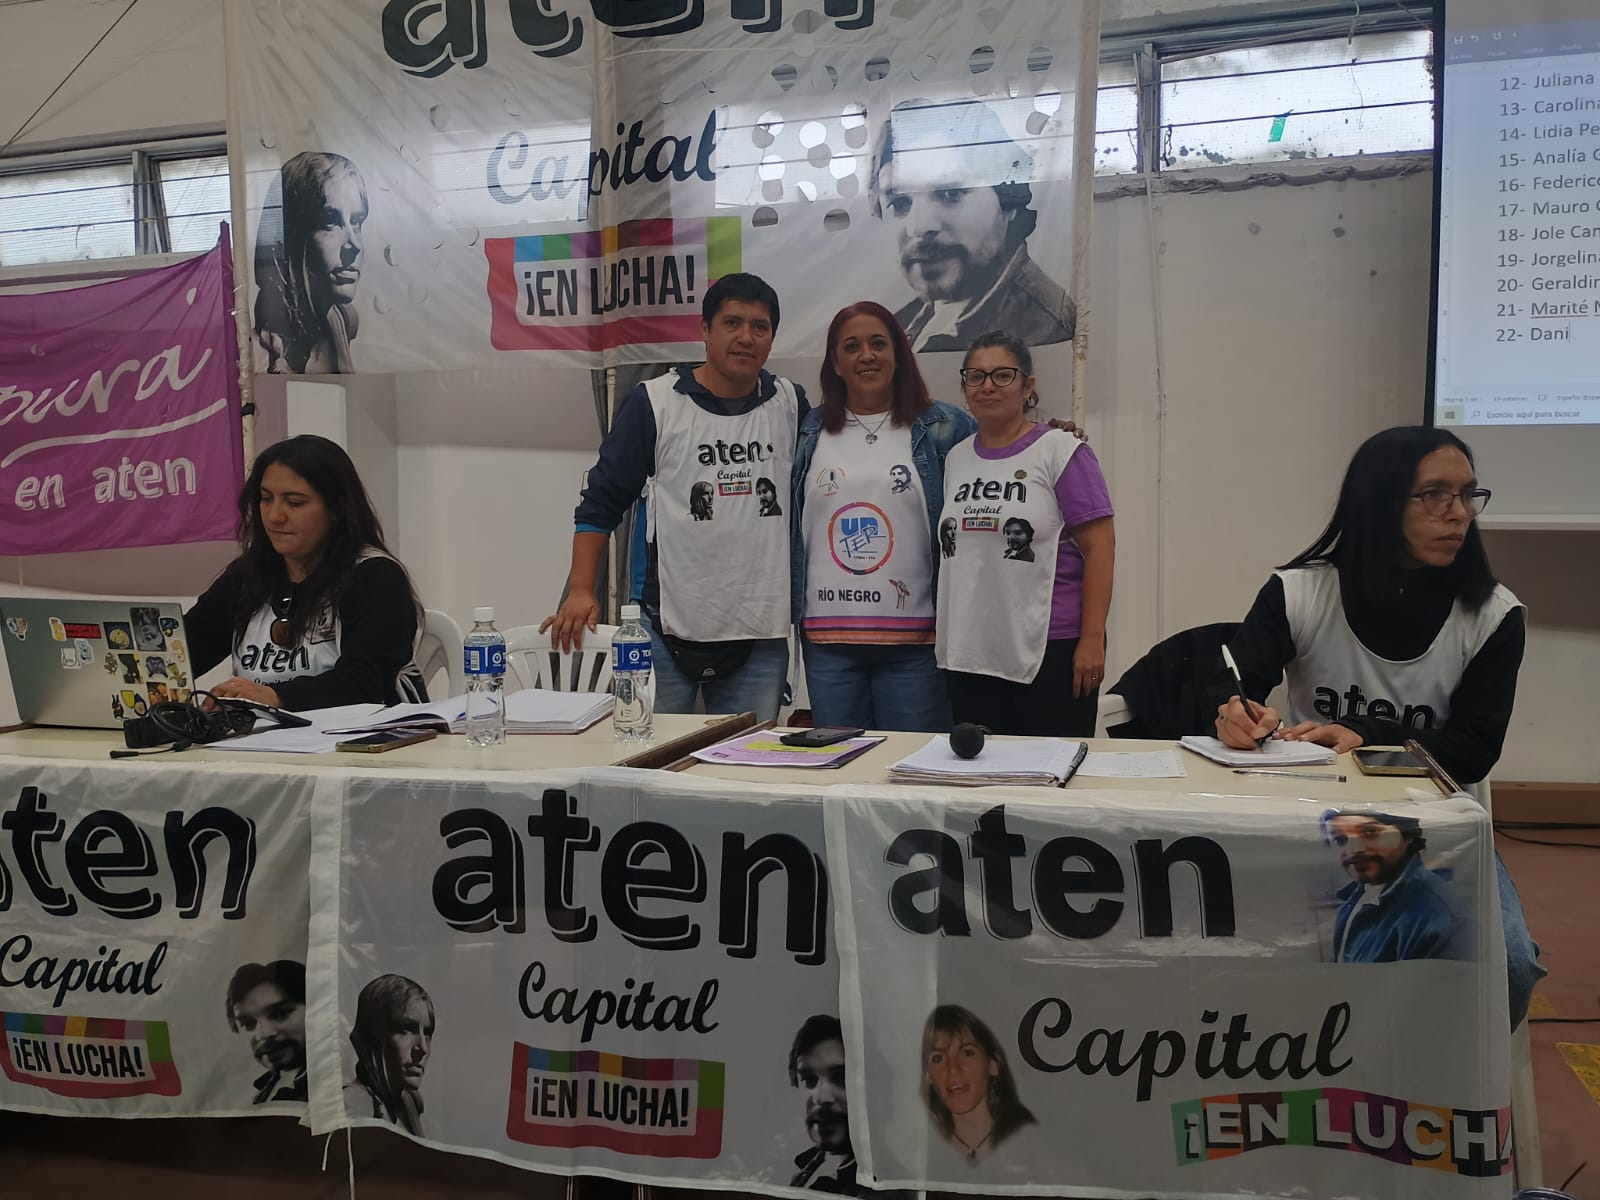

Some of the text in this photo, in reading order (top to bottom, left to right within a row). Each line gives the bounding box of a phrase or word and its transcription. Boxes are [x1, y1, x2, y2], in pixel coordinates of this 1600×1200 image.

[1500, 73, 1594, 91] 12- Juliana
[1500, 103, 1526, 117] 13-
[1500, 128, 1526, 142] 14-
[1534, 124, 1573, 139] Lidia
[487, 105, 728, 221] Capital
[1499, 154, 1526, 167] 15-
[1533, 148, 1586, 165] Analía
[1499, 179, 1526, 192] 16-
[1498, 204, 1525, 217] 17-
[1533, 201, 1590, 215] Mauro
[1498, 229, 1525, 242] 18-
[1531, 226, 1565, 240] Jole
[1498, 250, 1600, 268] 19- Jorgelin
[524, 255, 695, 317] ¡EN LUCHA!
[1497, 278, 1524, 292] 20-
[1496, 303, 1523, 317] 21-
[1531, 299, 1589, 316] Marité
[1496, 327, 1569, 342] 22- Dani
[697, 440, 764, 466] aten
[15, 457, 196, 511] en aten
[717, 469, 752, 481] Capital
[954, 478, 1026, 503] aten
[963, 505, 1002, 516] Capital
[818, 587, 881, 603] RÍO NEGRO
[241, 643, 310, 673] aten
[1313, 684, 1437, 730] aten
[0, 786, 257, 920] ten
[432, 788, 829, 966] aten
[884, 803, 1237, 942] aten
[0, 935, 168, 1008] Capital
[518, 961, 720, 1043] Capital
[12, 1036, 146, 1078] ¡EN LUCHA!
[1017, 997, 1355, 1102] Capital
[531, 1075, 689, 1128] ¡EN LUCHA!
[1184, 1103, 1289, 1160] ¡EN
